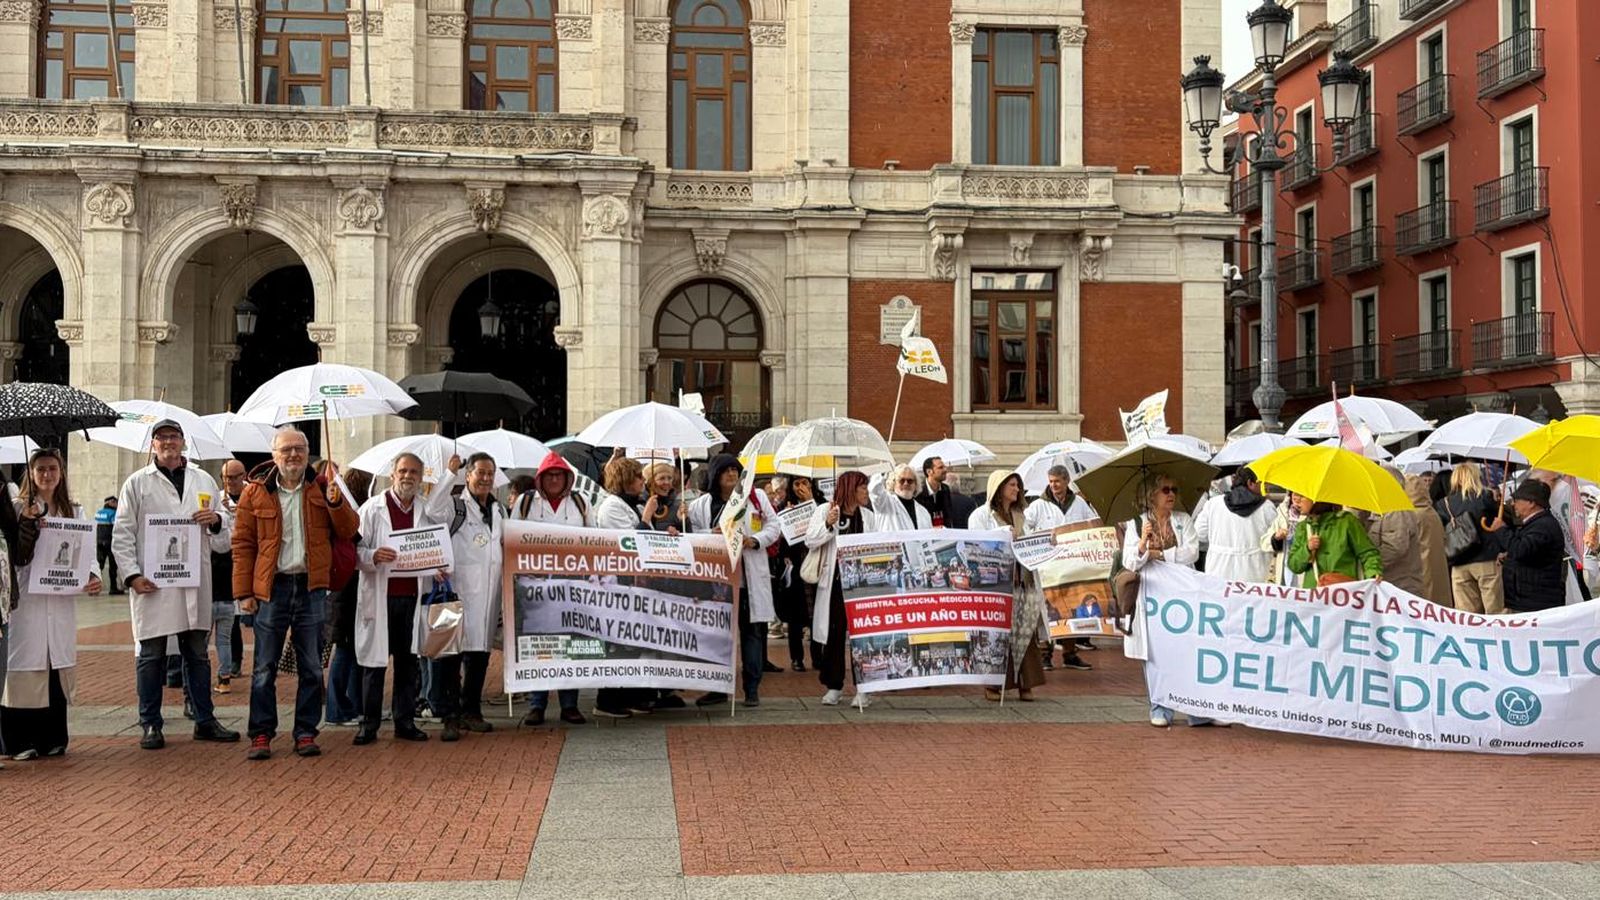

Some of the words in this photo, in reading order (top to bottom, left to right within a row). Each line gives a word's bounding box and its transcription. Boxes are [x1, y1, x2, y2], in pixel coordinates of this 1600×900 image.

[64, 523, 93, 532] HUMANOS
[405, 532, 434, 542] PRIMARIA
[400, 540, 440, 552] DESTROZADA
[521, 533, 574, 545] Sindicato
[580, 536, 617, 546] Médico
[518, 554, 590, 572] HUELGA
[593, 552, 655, 572] MÉDIC
[856, 600, 896, 610] MINISTRA,
[898, 598, 938, 606] ESCUCHA,
[1224, 581, 1365, 610] ¡SALVEMOS
[1373, 593, 1402, 614] LA
[526, 586, 544, 600] OR
[547, 586, 566, 600] UN
[570, 586, 630, 610] ESTATUTO
[634, 594, 649, 614] DE
[652, 598, 668, 618] LA
[670, 602, 732, 631] PROFESIÓN
[854, 614, 881, 628] MÁS
[886, 613, 902, 624] DE
[907, 612, 926, 623] UN
[930, 608, 957, 621] AÑO
[961, 610, 978, 620] EN
[562, 608, 602, 634] MÉDICA
[606, 618, 614, 636] Y
[617, 620, 698, 652] FACULTATIVA
[1145, 597, 1226, 638] POR
[1245, 606, 1320, 648] UN
[516, 667, 573, 680] MEDICO/AS
[576, 666, 589, 677] DE
[592, 666, 640, 676] ATENCION
[644, 666, 683, 678] PRIMARIA
[684, 668, 696, 679] DE
[1198, 648, 1288, 694] DEL
[1168, 692, 1214, 710] Asociación
[1217, 702, 1230, 712] de
[1232, 704, 1278, 718] Médicos
[1282, 710, 1323, 724] Unidos
[1328, 717, 1347, 728] por
[1352, 720, 1372, 732] sus
[1377, 724, 1436, 743] Derechos,
[1440, 734, 1470, 744] MUD
[1490, 738, 1584, 748] @mudmedicos
